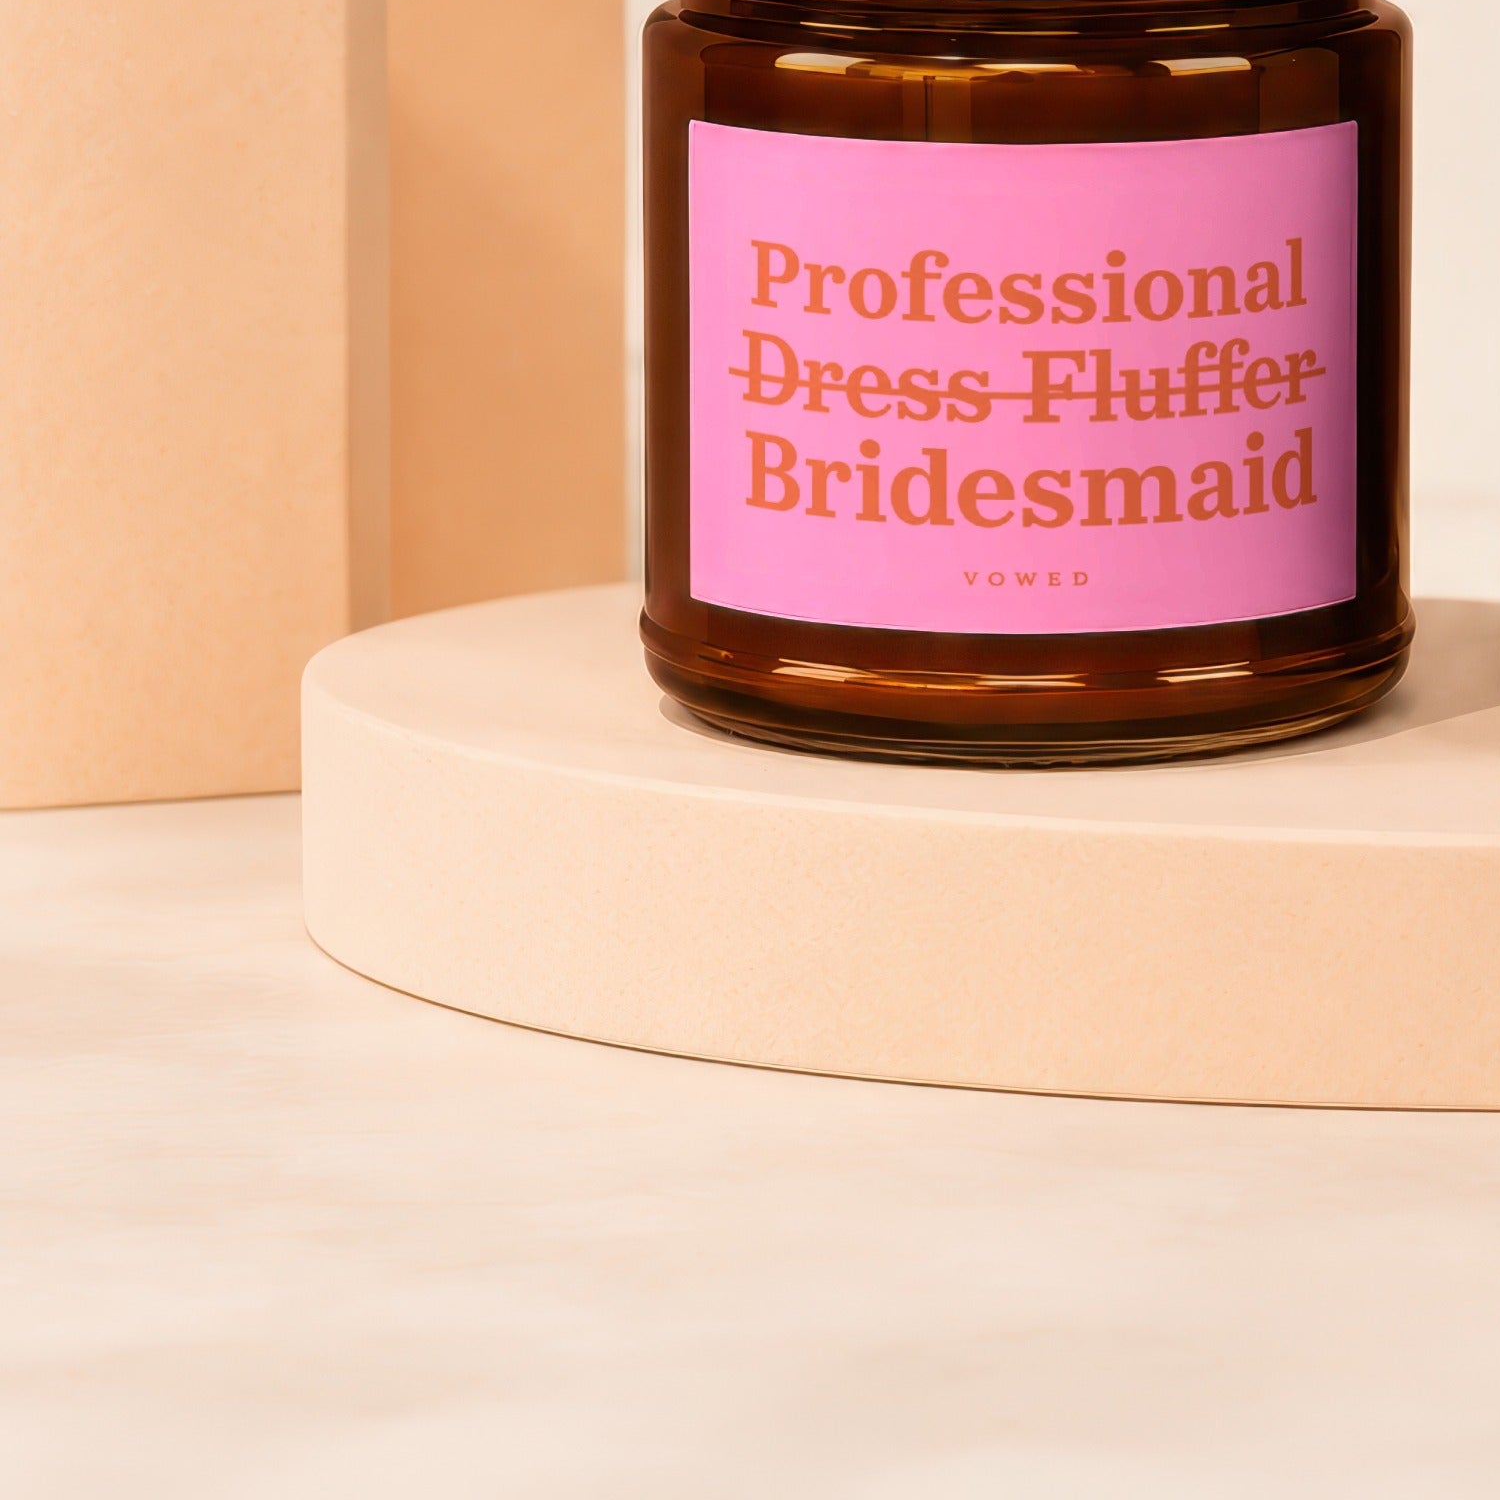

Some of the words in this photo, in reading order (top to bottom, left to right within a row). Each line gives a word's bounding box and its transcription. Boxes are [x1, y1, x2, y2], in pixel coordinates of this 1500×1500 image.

[750, 236, 1308, 325] Professional
[742, 329, 992, 422] Dress
[1022, 338, 1318, 424] Fluffer
[744, 426, 1319, 529] Bridesmaid
[963, 571, 1090, 587] VOWED
